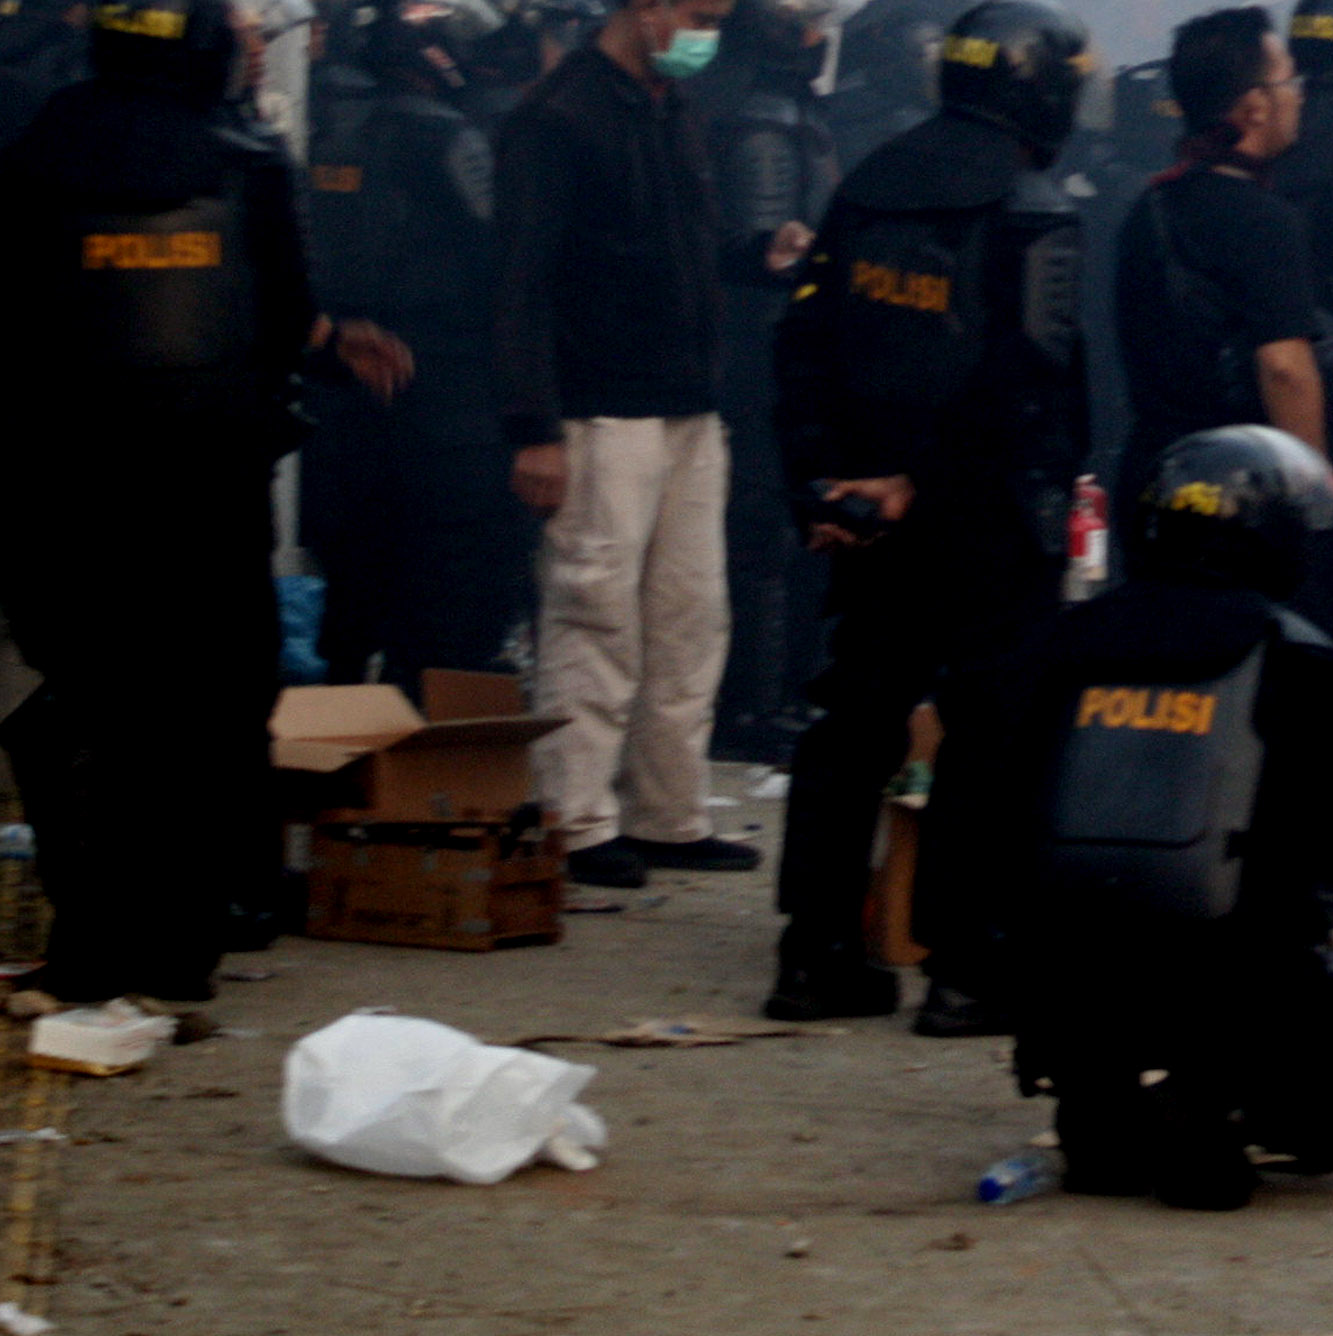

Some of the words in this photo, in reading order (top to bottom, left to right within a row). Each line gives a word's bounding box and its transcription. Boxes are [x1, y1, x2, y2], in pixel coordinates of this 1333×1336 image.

[82, 231, 223, 269] POLISI
[851, 260, 952, 313] POLISI
[1073, 685, 1219, 737] POLISI
